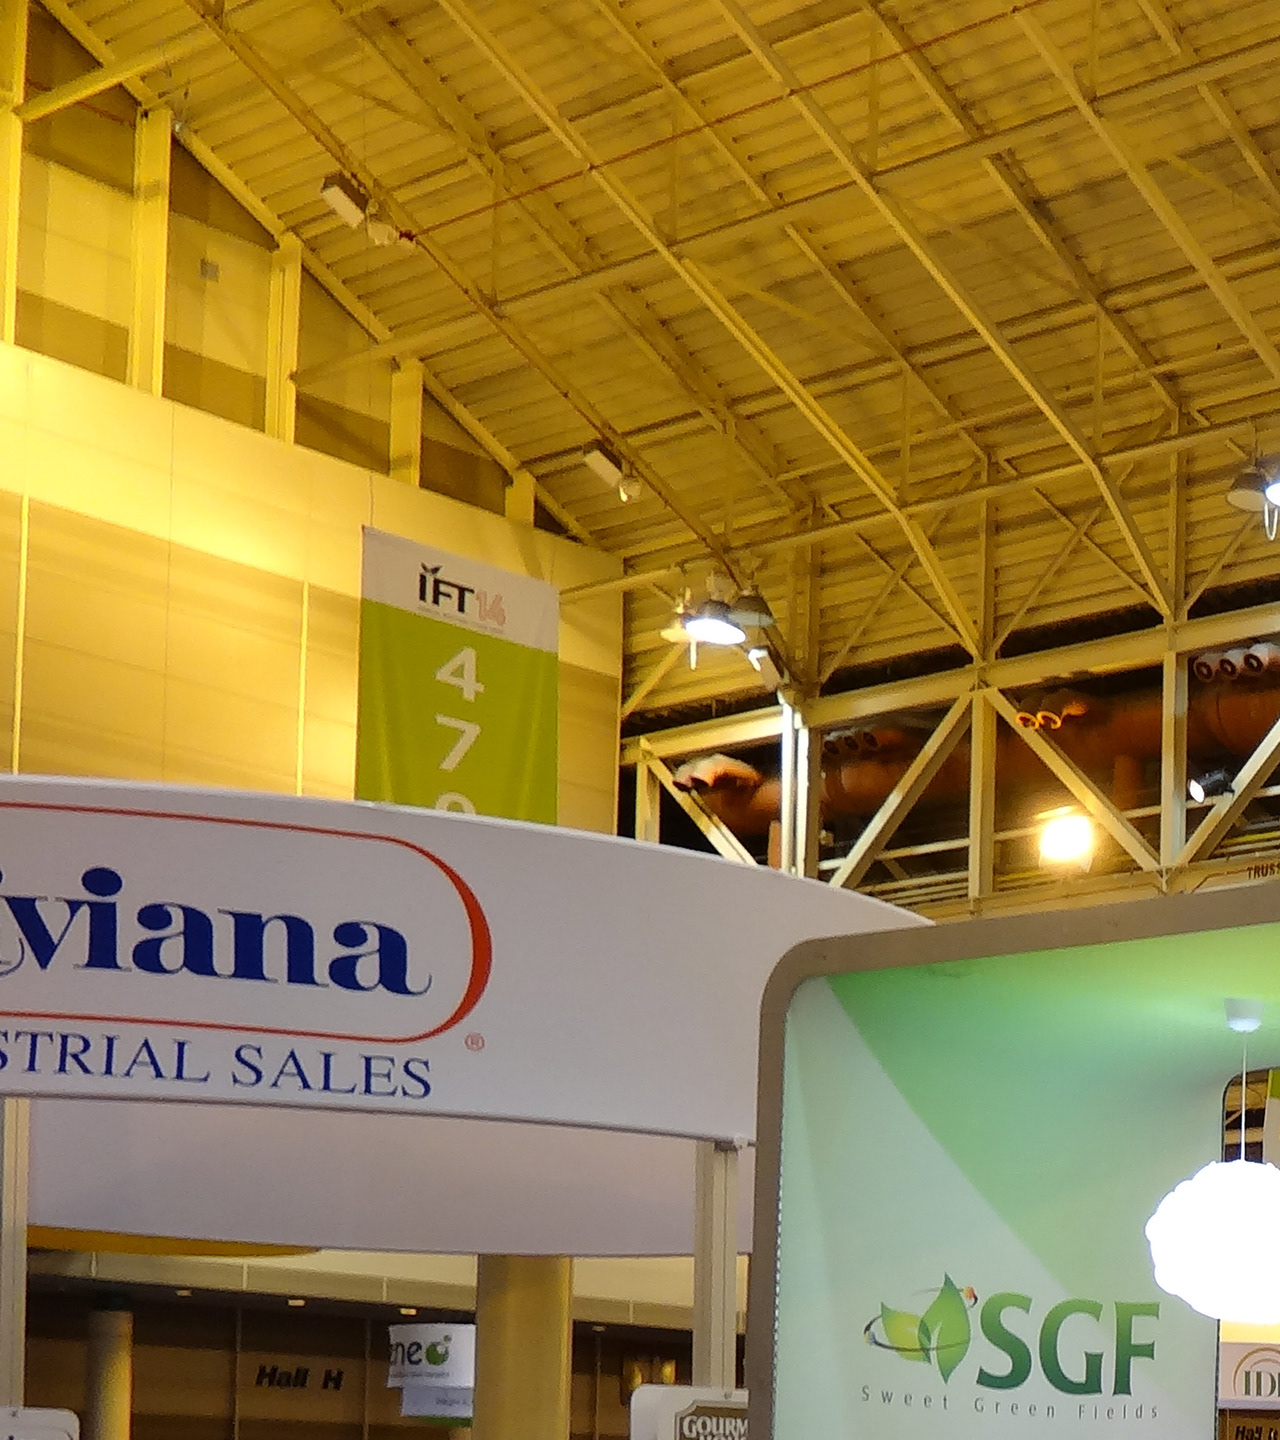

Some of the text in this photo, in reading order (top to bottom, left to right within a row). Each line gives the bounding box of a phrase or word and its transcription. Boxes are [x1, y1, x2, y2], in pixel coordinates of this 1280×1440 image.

[232, 1043, 432, 1099] SALES
[975, 1291, 1161, 1397] SGF
[255, 1364, 344, 1391] Hall H
[862, 1384, 1159, 1421] Sweet Green Fields
